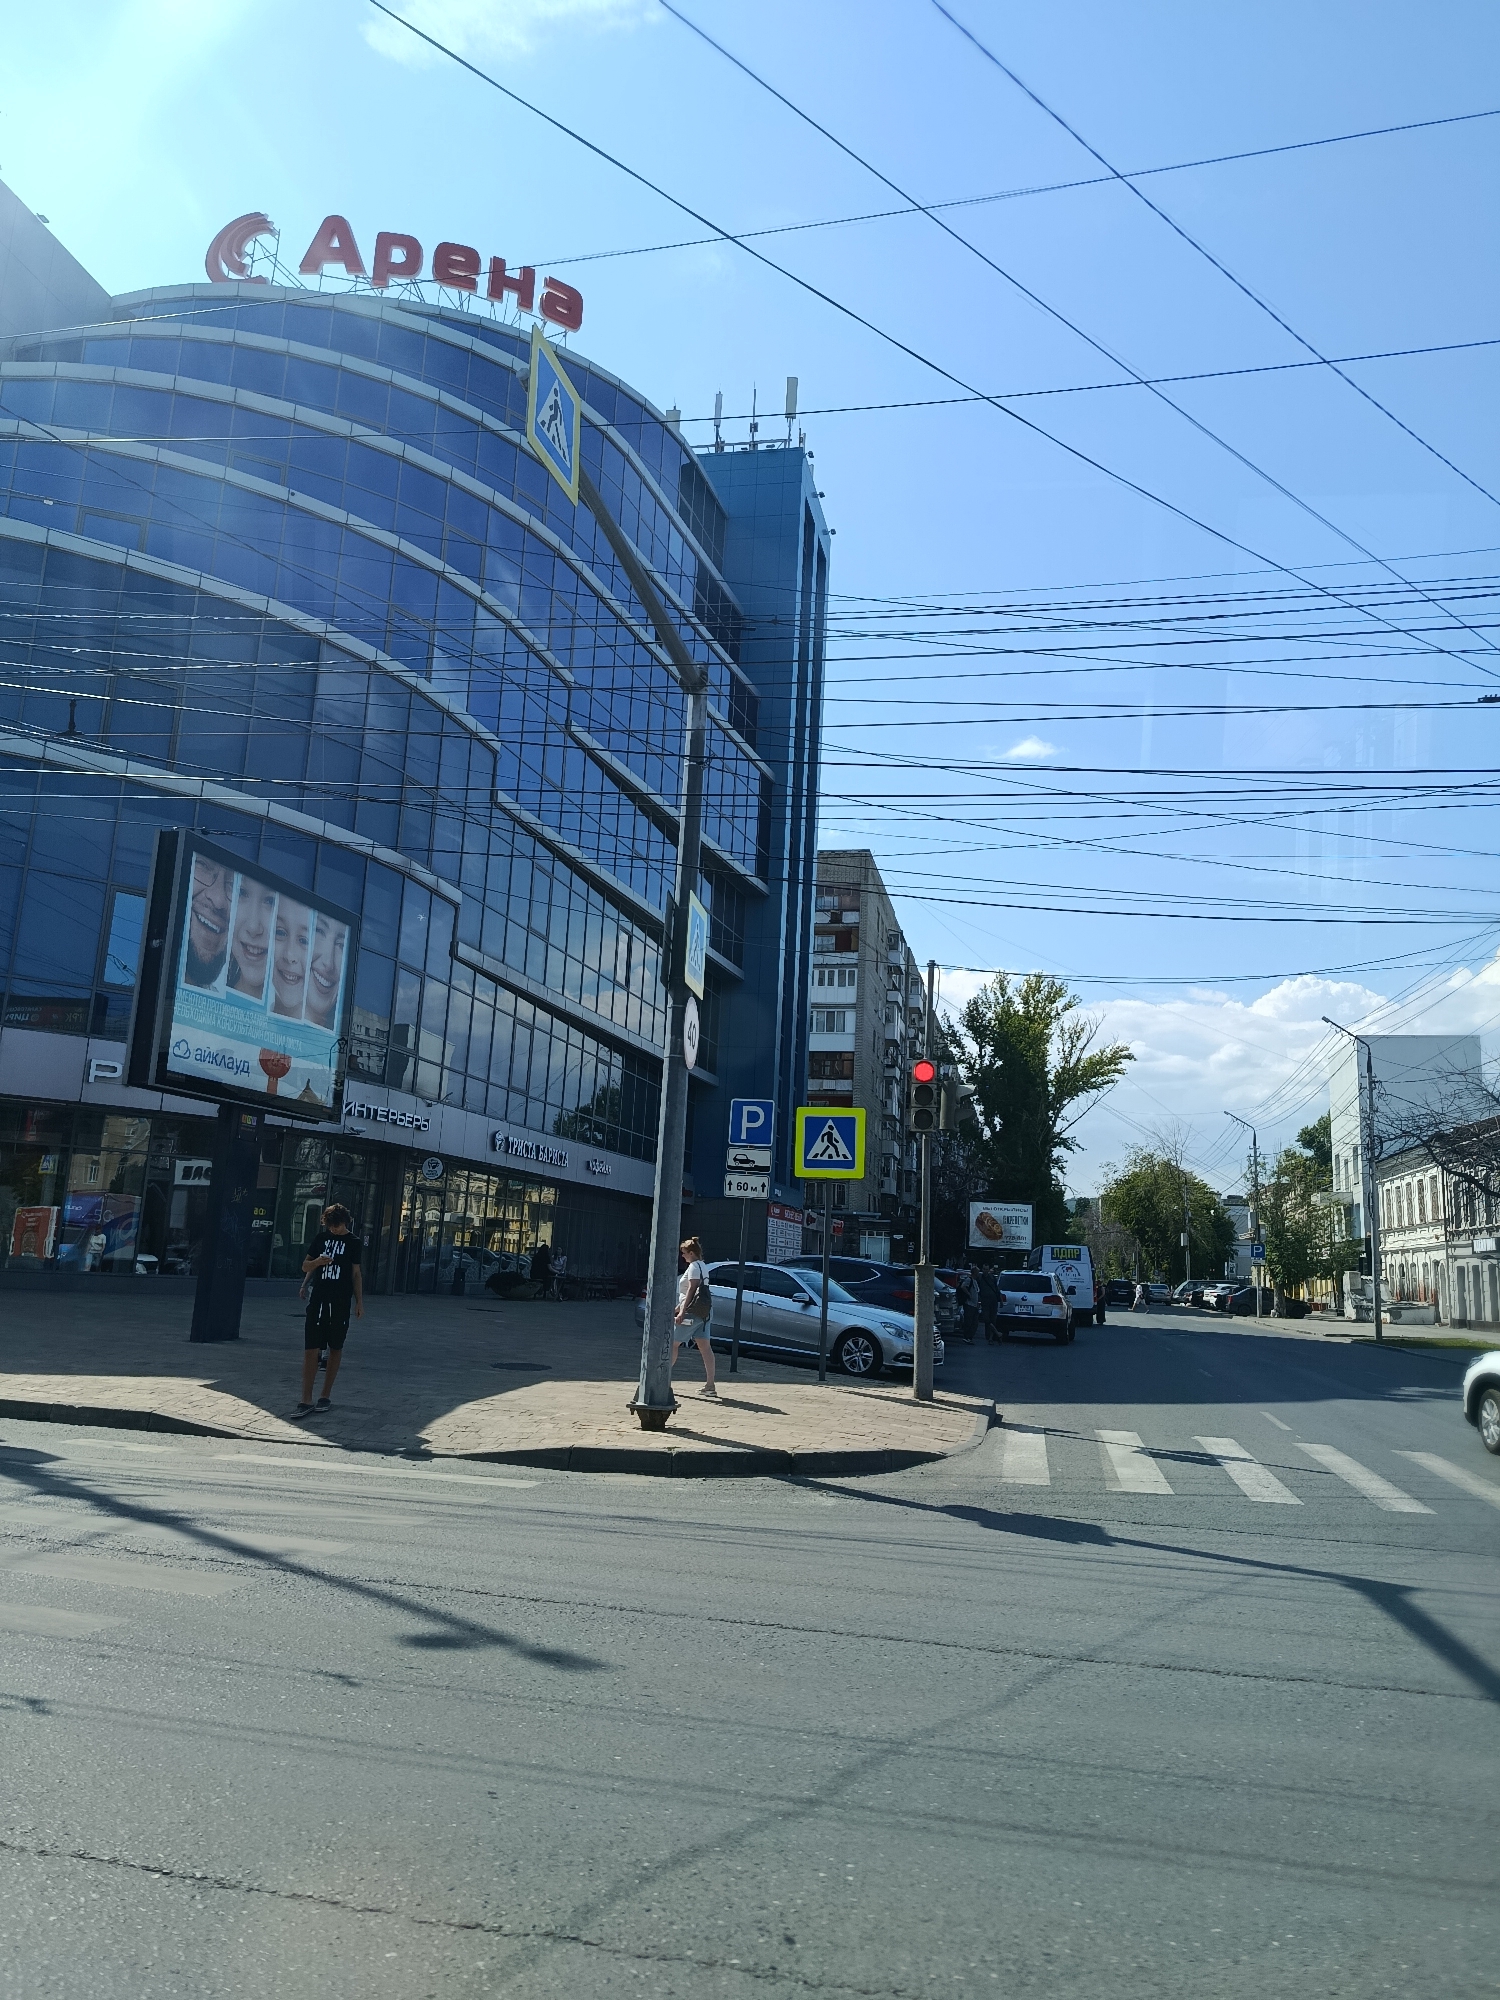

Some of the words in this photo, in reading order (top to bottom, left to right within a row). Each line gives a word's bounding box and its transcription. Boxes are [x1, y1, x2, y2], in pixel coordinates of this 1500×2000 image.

[298, 214, 584, 333] Арена
[687, 1020, 697, 1050] 40
[194, 1046, 251, 1077] айклауд
[342, 1099, 431, 1131] ИНТЕРЬЕРЫ
[740, 1105, 765, 1140] P
[507, 1135, 537, 1161] ТРИСТА
[538, 1143, 570, 1169] БАРИСТА
[736, 1181, 749, 1192] 60
[1052, 1247, 1080, 1260] ЛДПР
[1253, 1245, 1263, 1257] P
